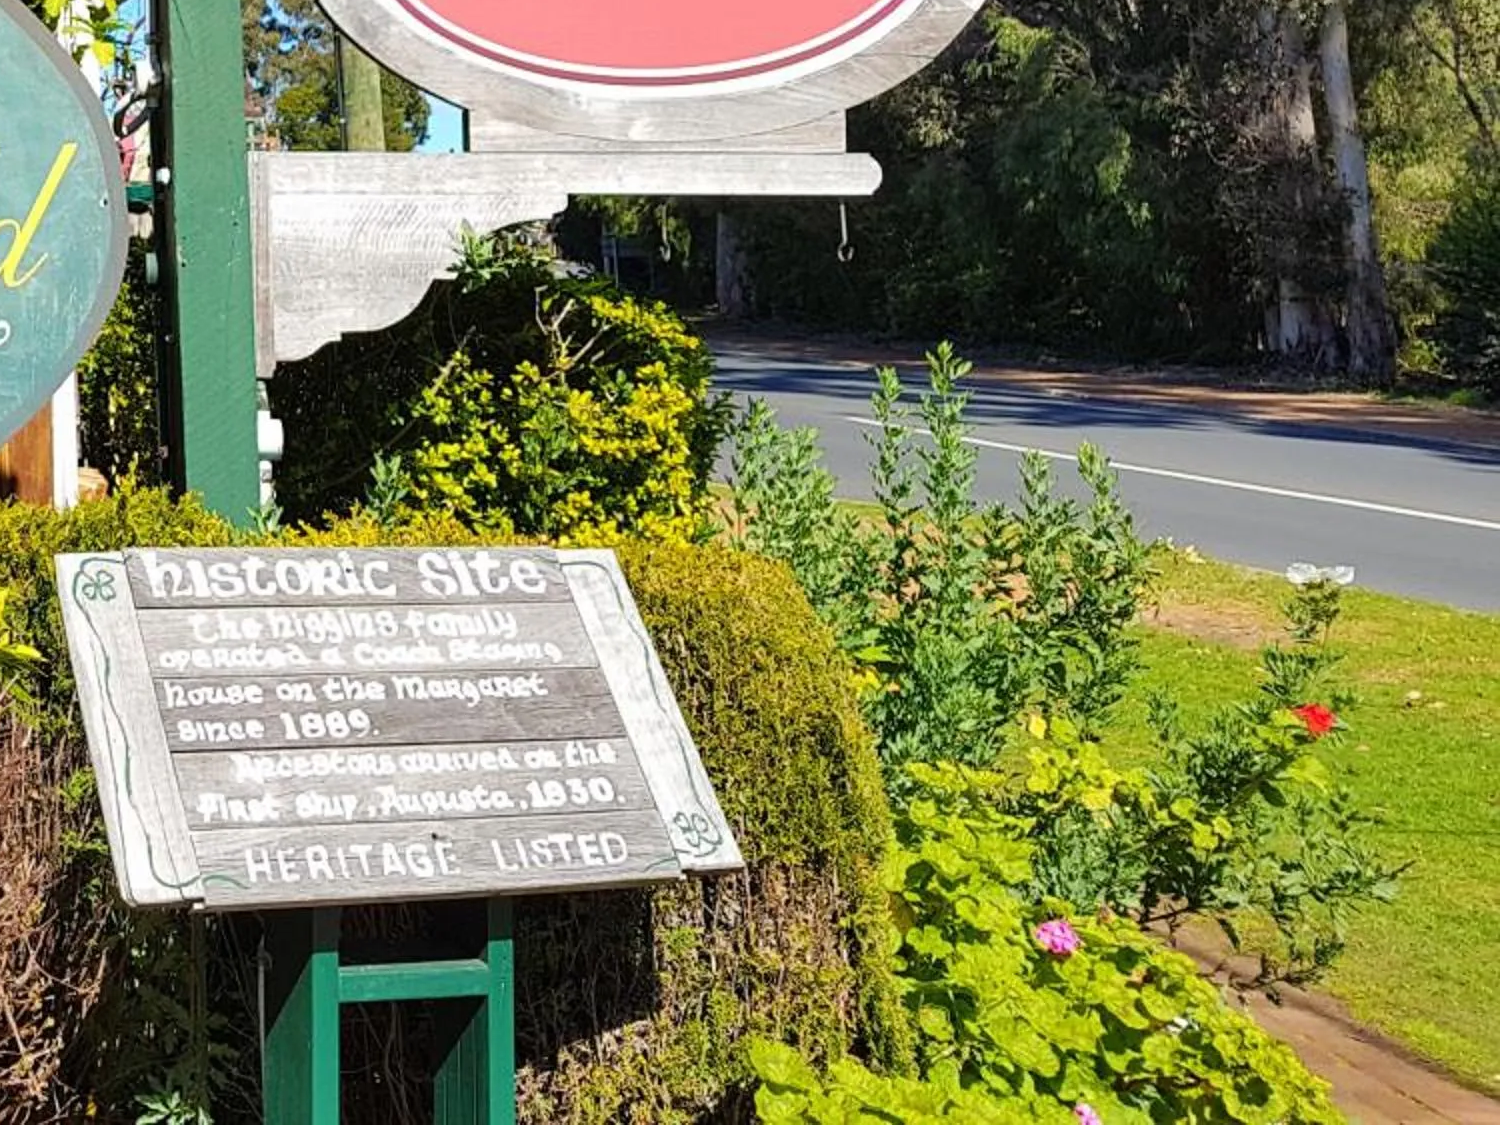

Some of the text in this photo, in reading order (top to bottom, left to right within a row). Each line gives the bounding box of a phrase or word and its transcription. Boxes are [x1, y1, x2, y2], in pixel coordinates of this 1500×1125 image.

[275, 681, 317, 702] on
[322, 676, 386, 700] the
[391, 672, 548, 707] Margaret
[280, 709, 380, 740] 1889.
[523, 748, 563, 769] on
[565, 740, 619, 768] the
[244, 831, 628, 883] HERITAGE LISTED
